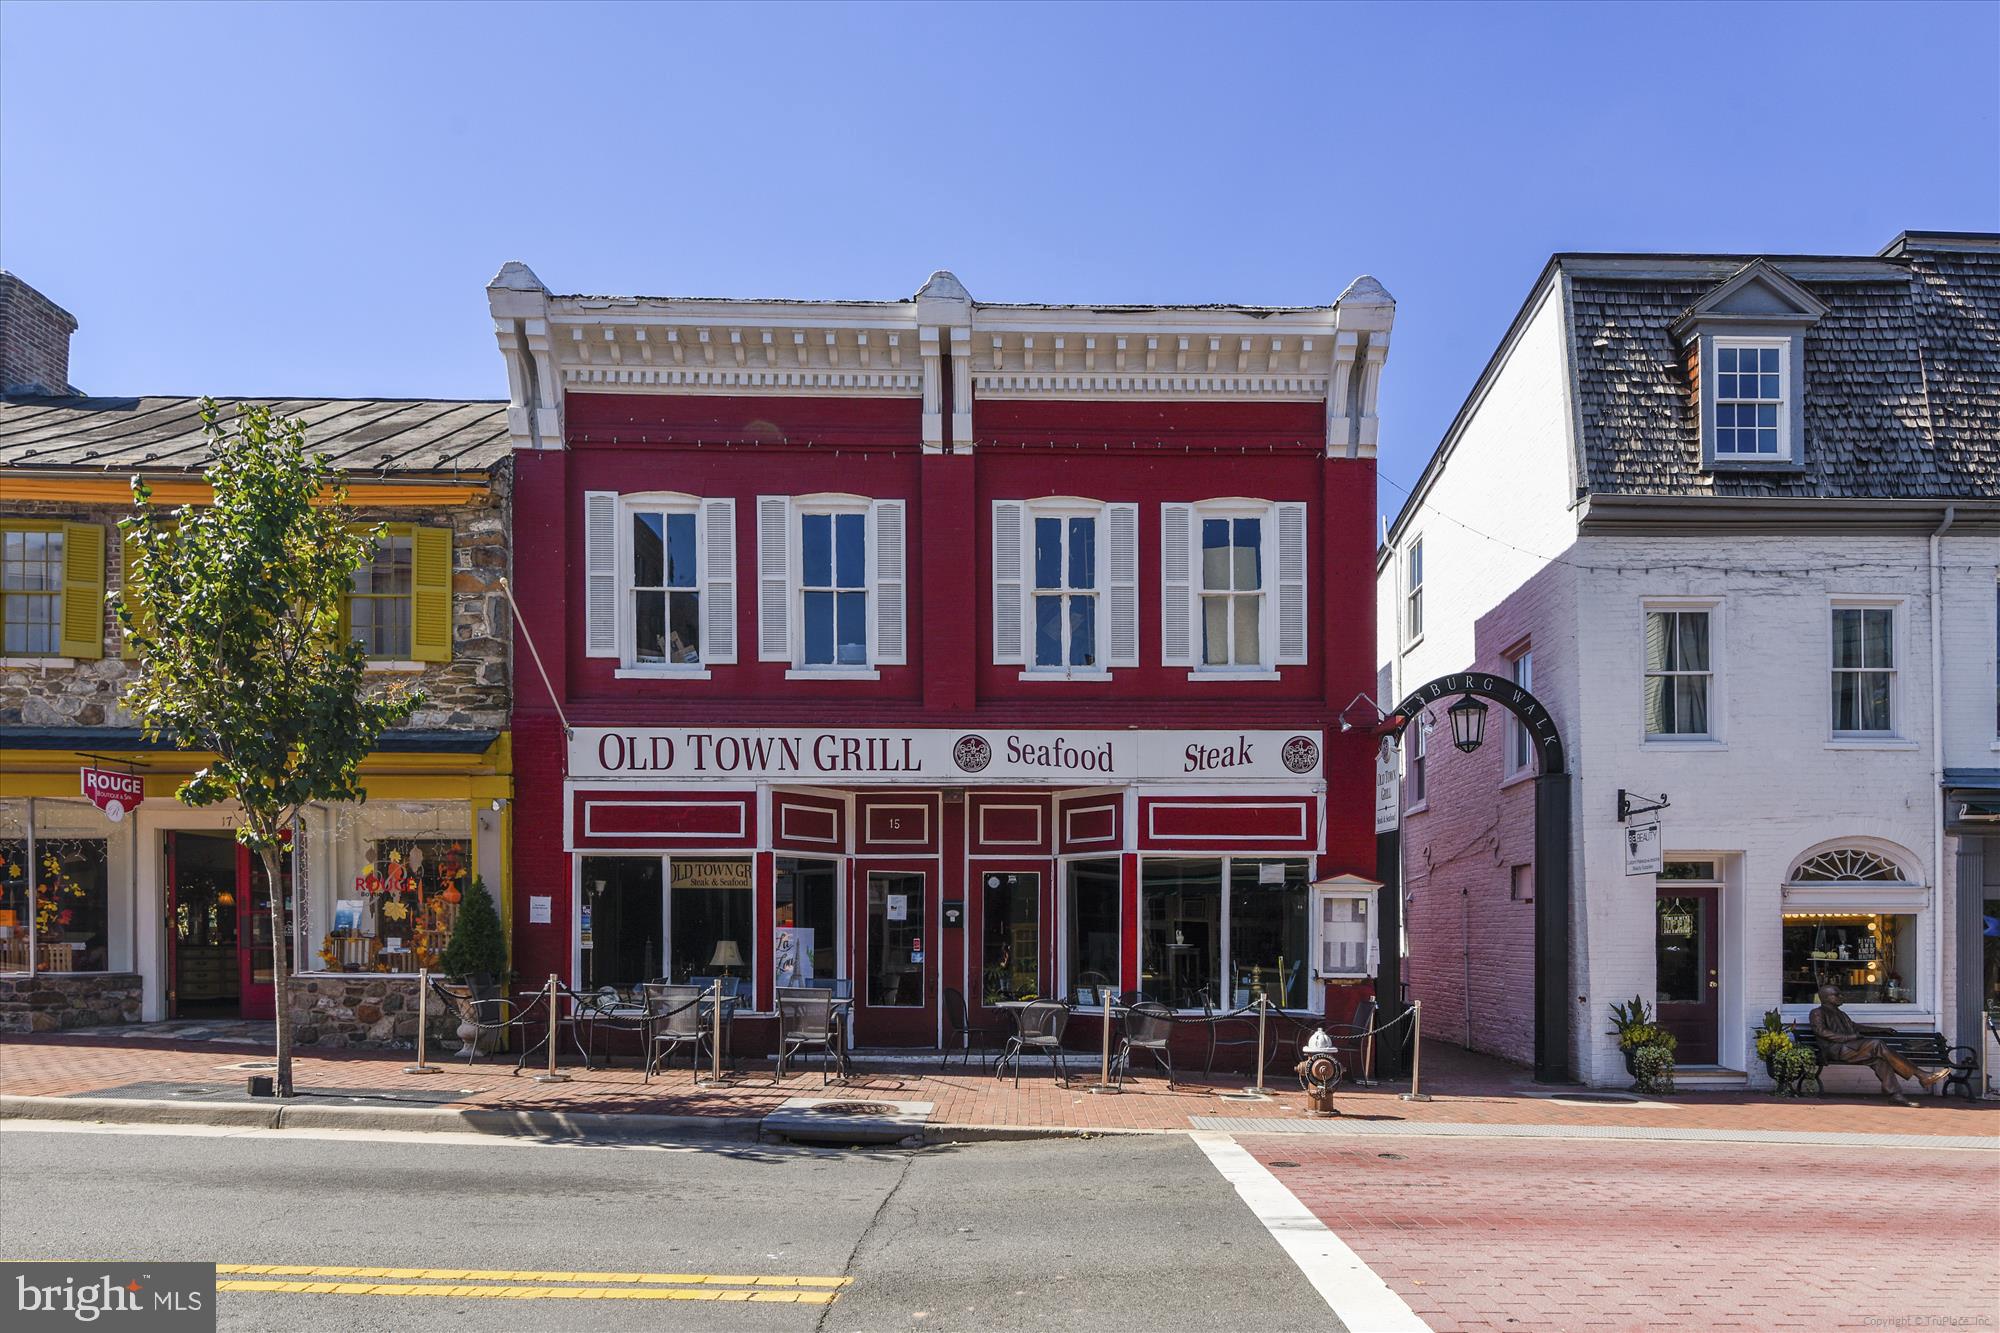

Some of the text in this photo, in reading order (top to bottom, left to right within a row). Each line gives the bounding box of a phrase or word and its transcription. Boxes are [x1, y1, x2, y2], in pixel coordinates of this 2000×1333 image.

[1512, 689, 1558, 747] WALK
[598, 733, 922, 772] OLD TOWN GRILL
[1007, 735, 1114, 773] Seafood
[1184, 735, 1254, 773] Steak
[87, 772, 141, 794] ROUGE
[222, 816, 233, 827] 17
[889, 818, 900, 829] 15
[1637, 831, 1657, 843] BEAUTY
[694, 863, 733, 877] TOWN
[690, 877, 749, 887] Steak & Seafood
